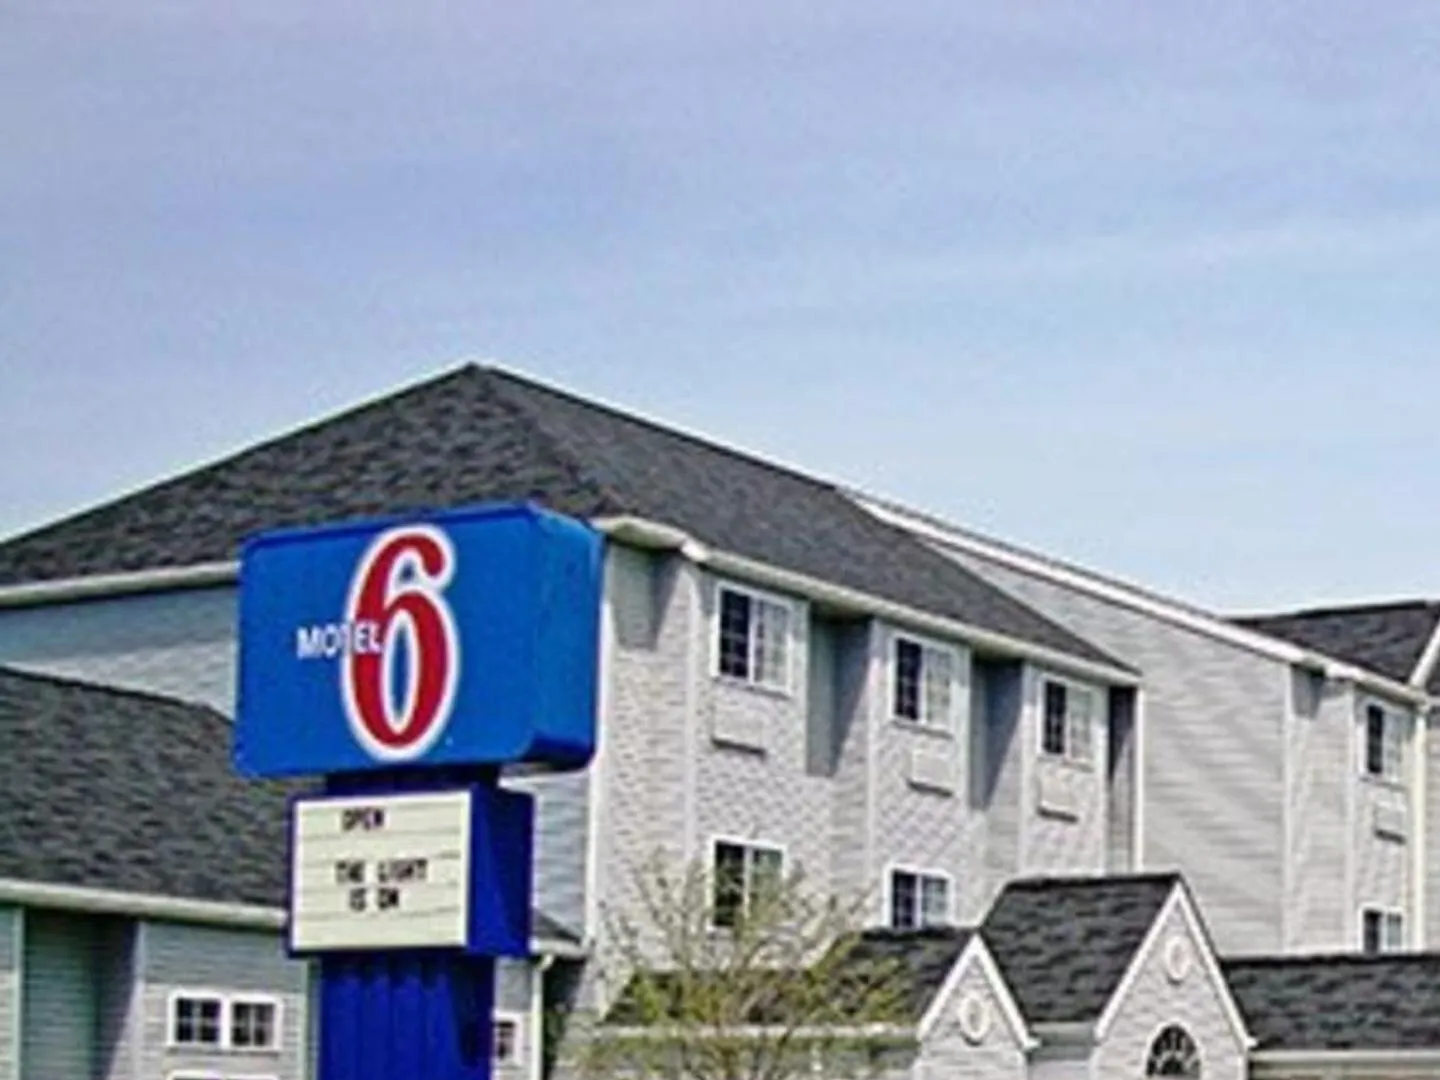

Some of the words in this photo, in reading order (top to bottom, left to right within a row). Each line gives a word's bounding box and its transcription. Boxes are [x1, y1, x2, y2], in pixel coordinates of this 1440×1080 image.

[297, 622, 384, 659] MOTEL
[341, 523, 460, 761] 6
[342, 807, 385, 831] OPEN
[335, 860, 365, 884] THE
[378, 858, 428, 884] LIGHT
[349, 887, 367, 912] IS
[377, 887, 399, 911] ON
